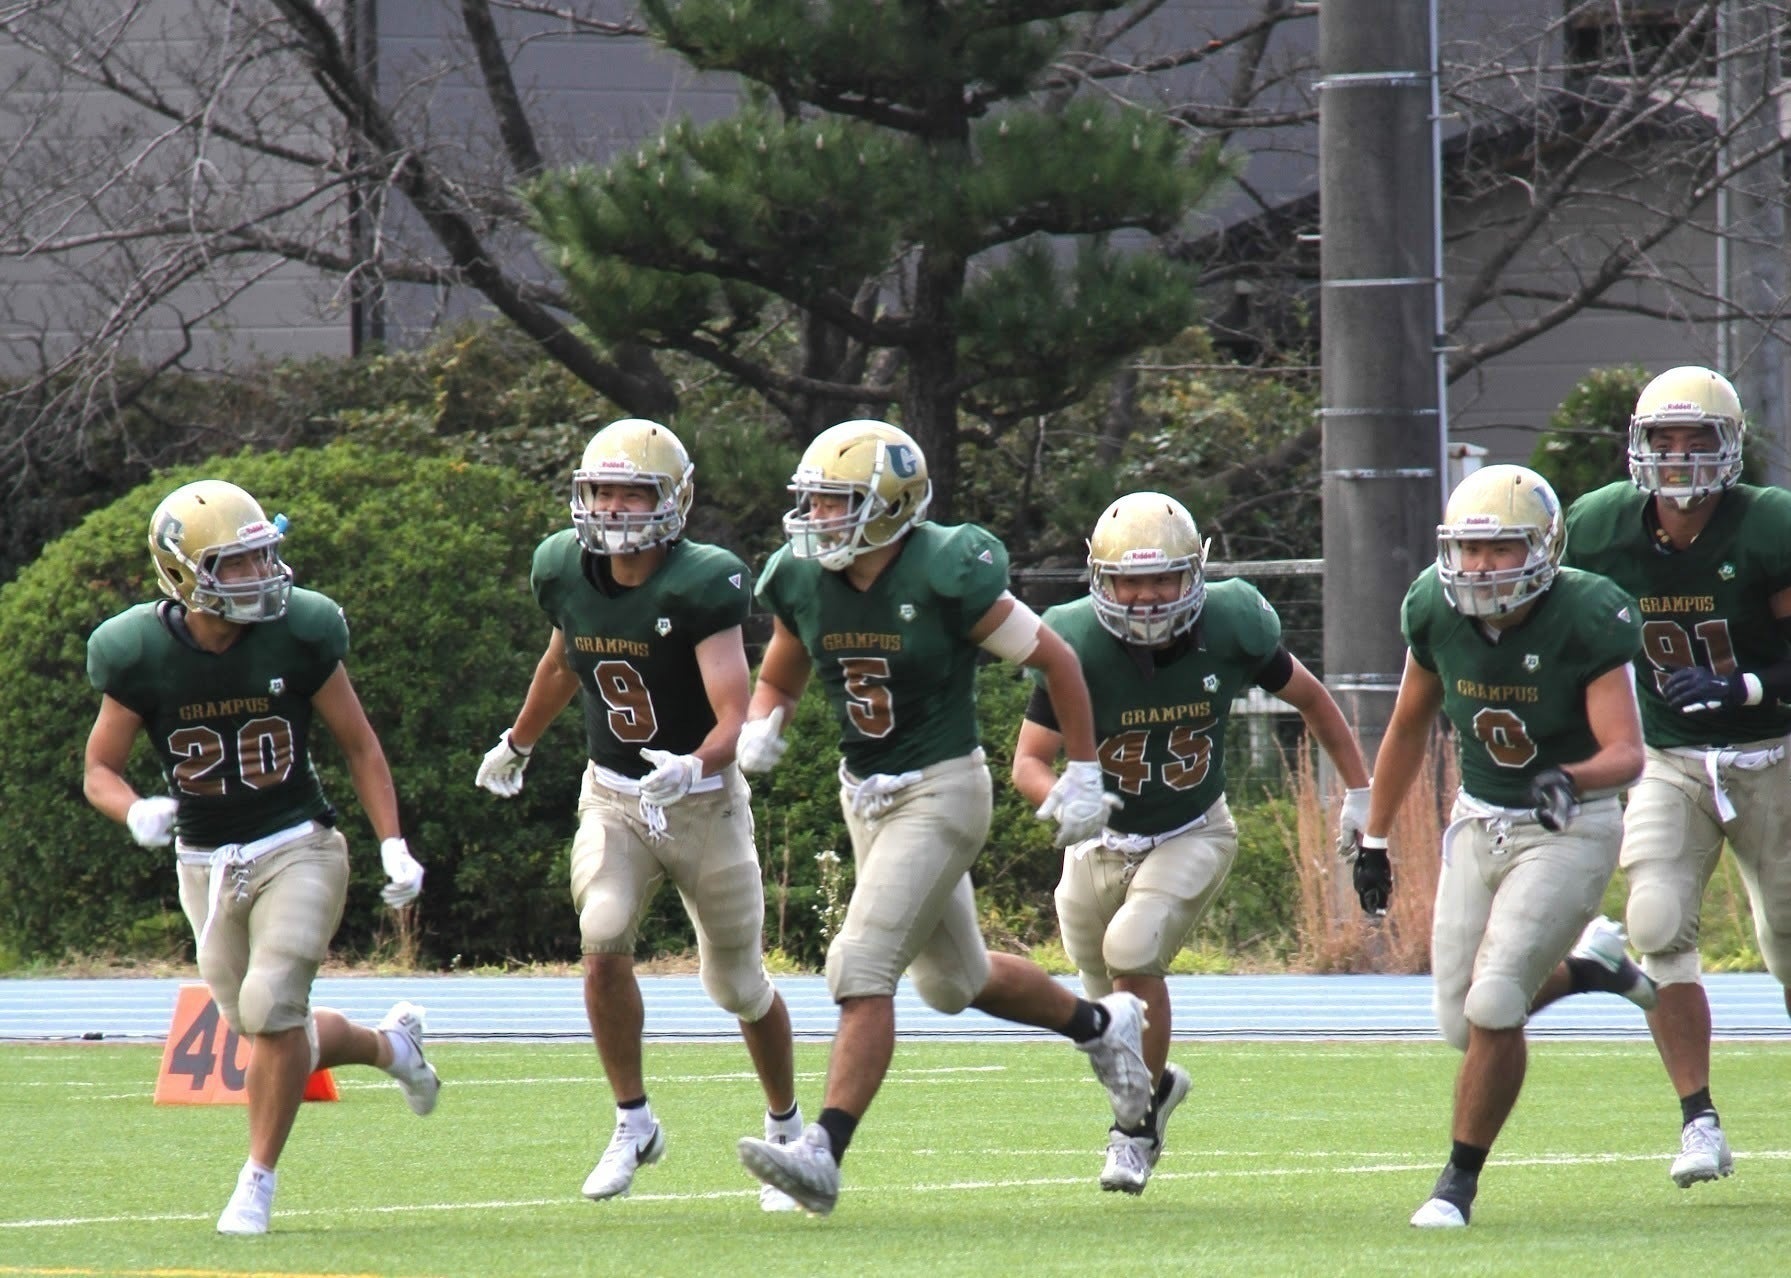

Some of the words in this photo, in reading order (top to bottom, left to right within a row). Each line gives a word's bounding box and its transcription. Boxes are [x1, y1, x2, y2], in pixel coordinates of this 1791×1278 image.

[1639, 596, 1715, 613] GRAMPUS
[574, 636, 649, 657] GRAMPUS
[822, 633, 901, 651] GRAMPUS
[594, 660, 659, 743] 9
[837, 656, 896, 739] 5
[1456, 679, 1539, 703] GRAMPUS
[179, 697, 270, 721] GRAMPUS
[1121, 701, 1212, 726] GRAMPUS
[1473, 707, 1538, 769] 0
[167, 716, 295, 796] 20
[1097, 718, 1219, 796] 45
